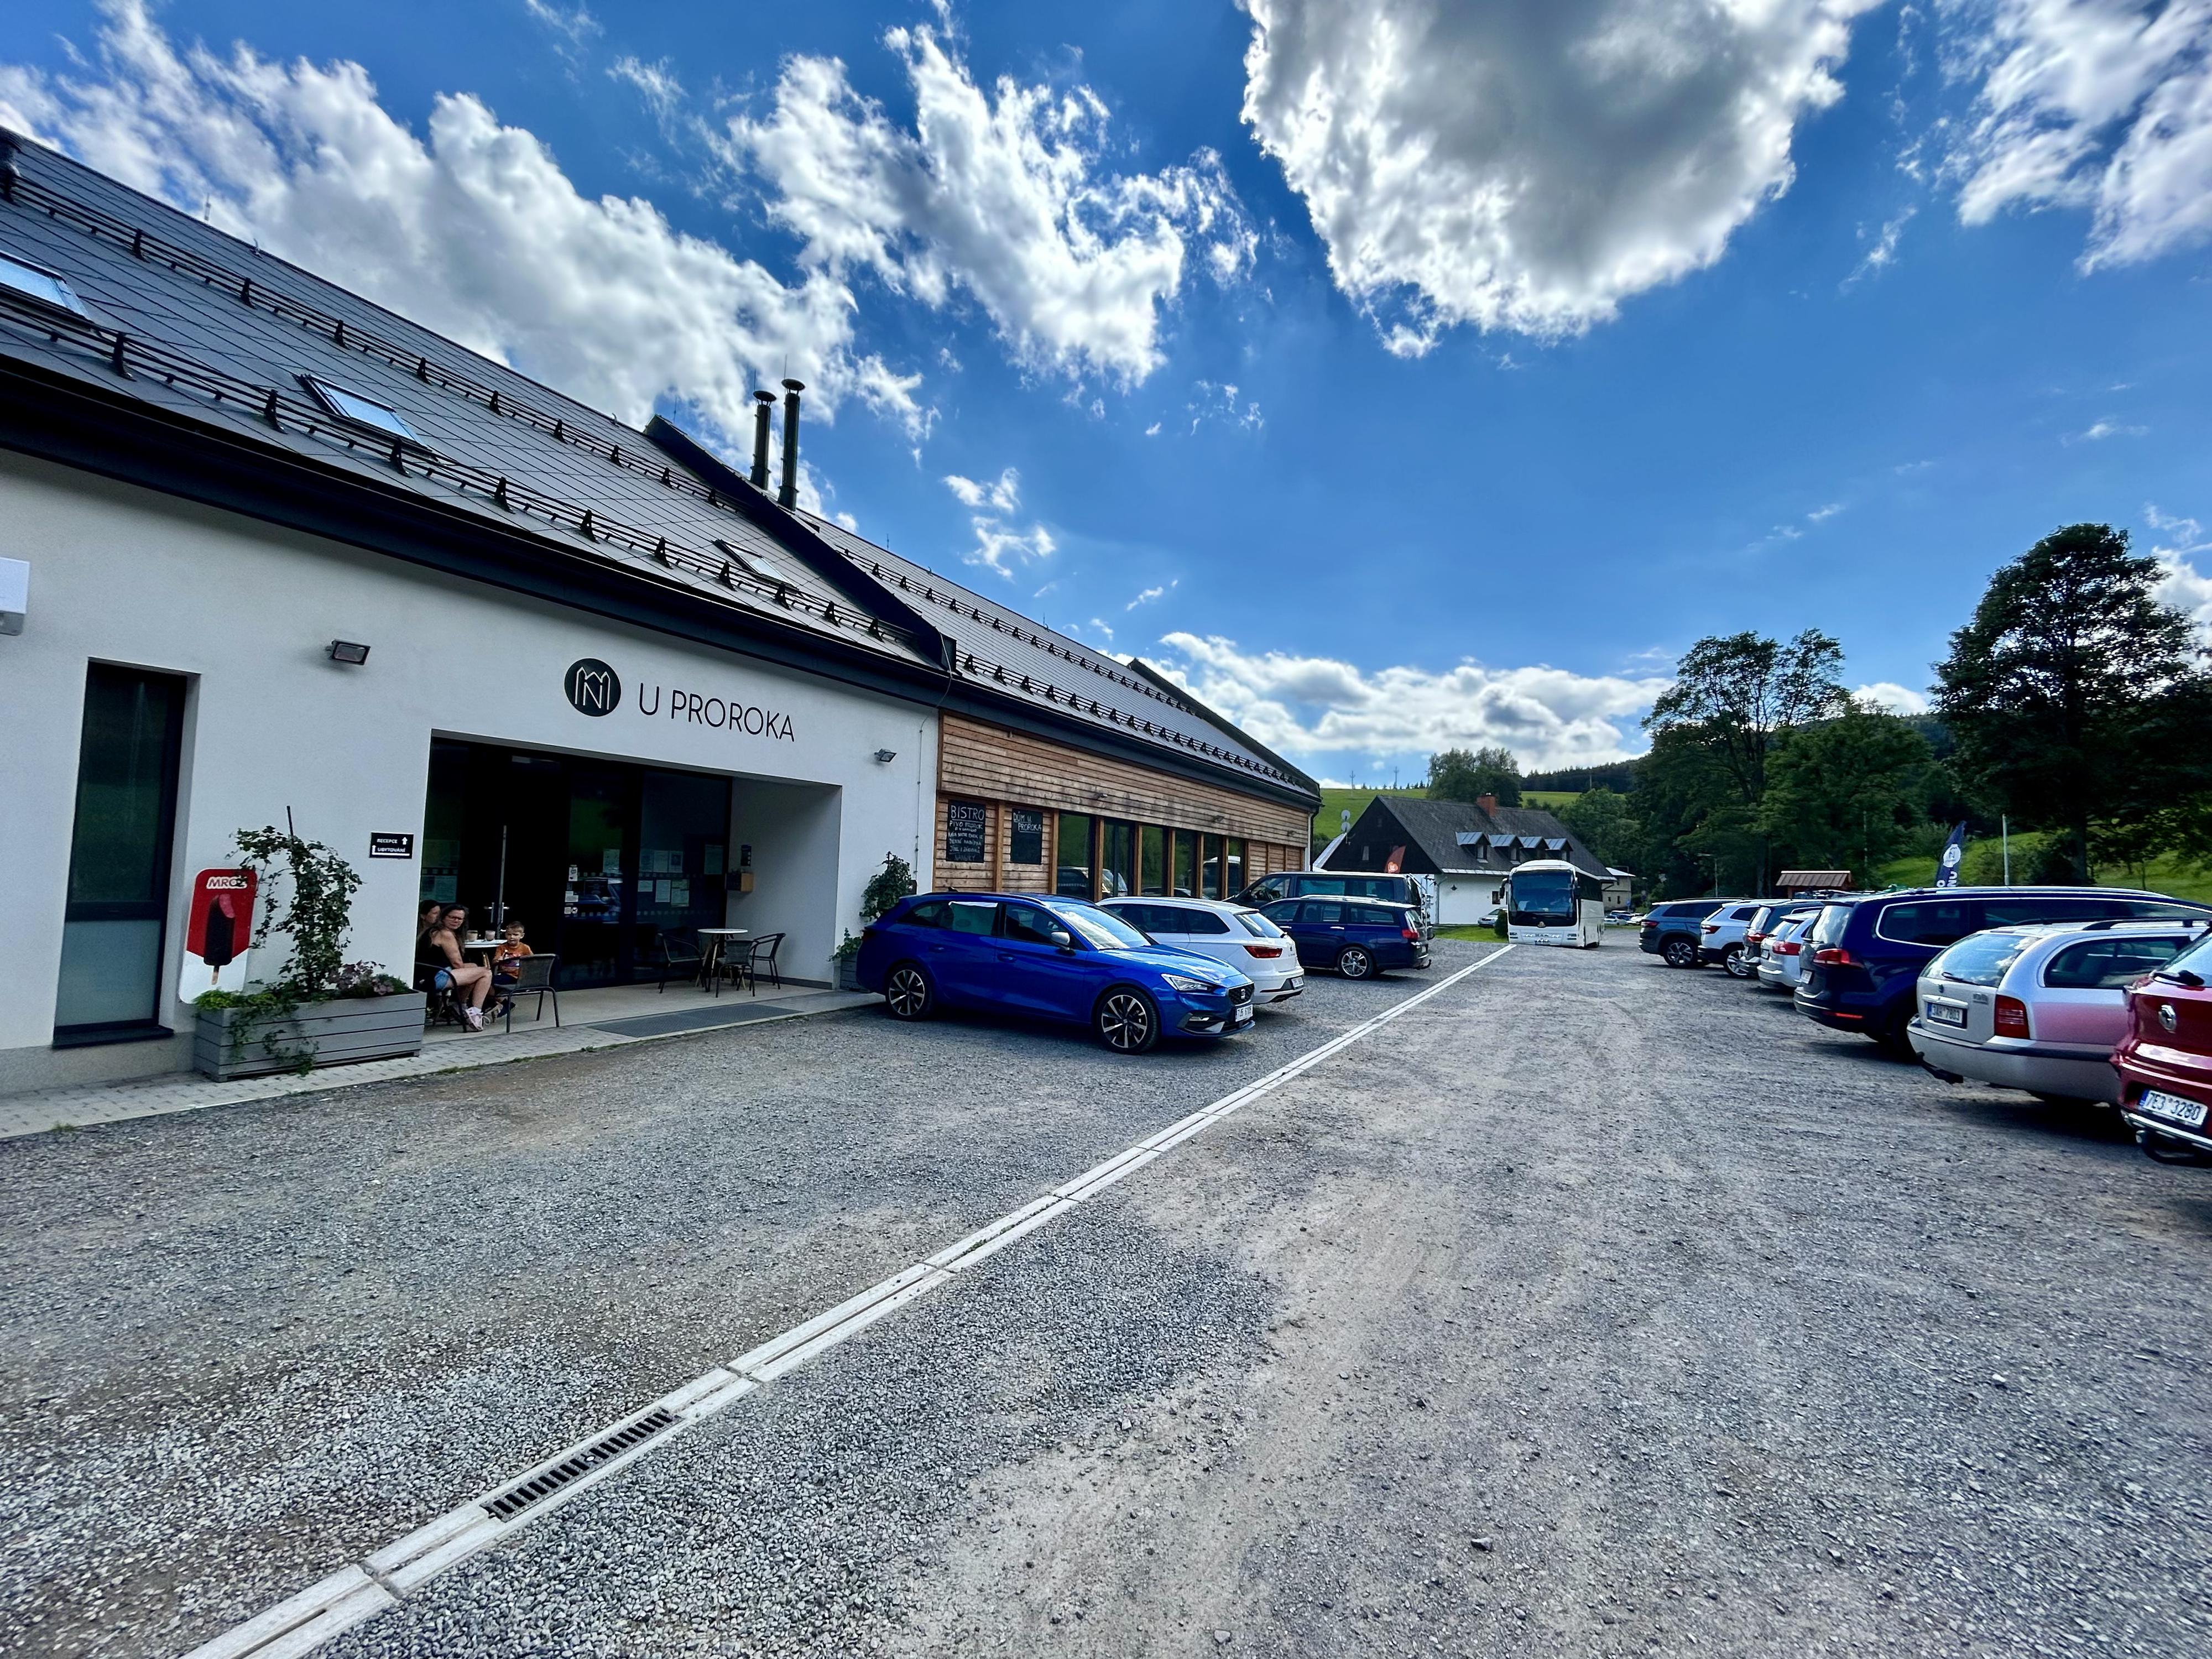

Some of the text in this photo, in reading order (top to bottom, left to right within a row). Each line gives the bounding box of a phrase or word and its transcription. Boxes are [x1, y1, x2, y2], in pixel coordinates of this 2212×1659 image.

[639, 682, 795, 742] U PROROKA
[951, 805, 984, 821] BISTRO
[1018, 822, 1042, 831] PROROKA
[2146, 1092, 2201, 1120] 7E3 3280
